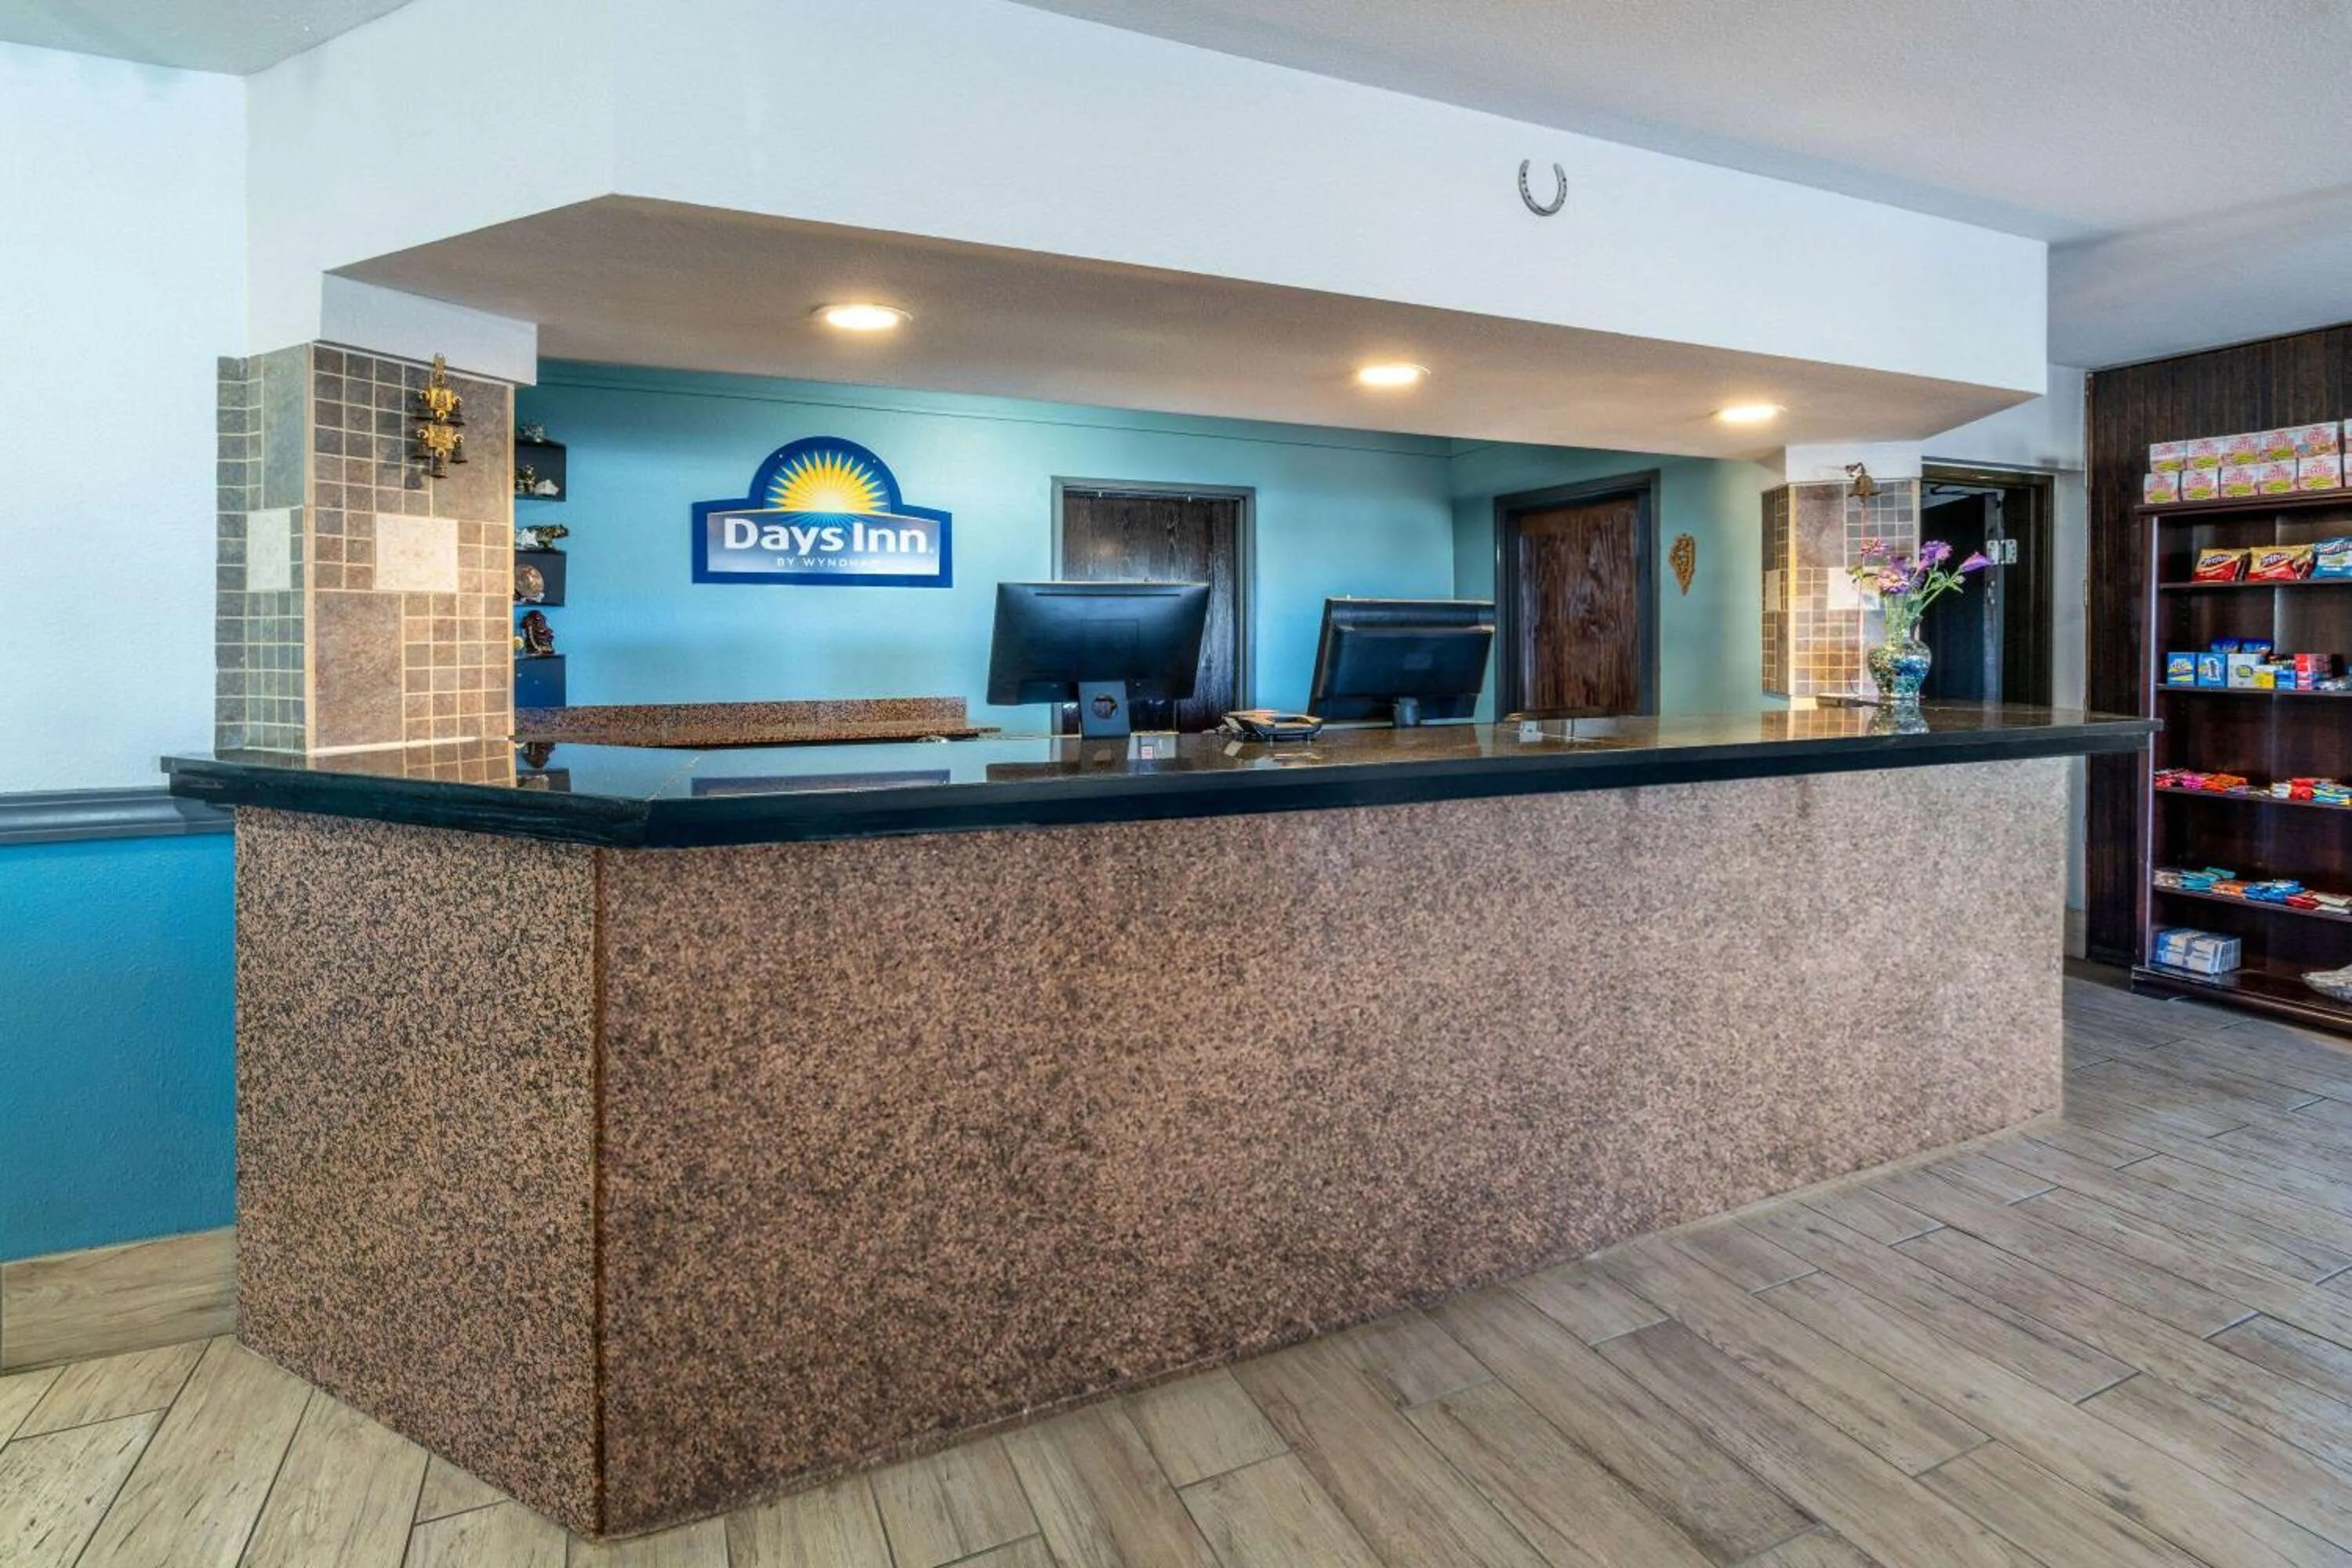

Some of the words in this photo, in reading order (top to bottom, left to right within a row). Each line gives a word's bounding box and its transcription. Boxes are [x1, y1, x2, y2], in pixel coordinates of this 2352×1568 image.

[724, 517, 844, 556] Days
[853, 522, 929, 554] Inn
[777, 557, 795, 567] BY
[803, 557, 880, 568] WYND
